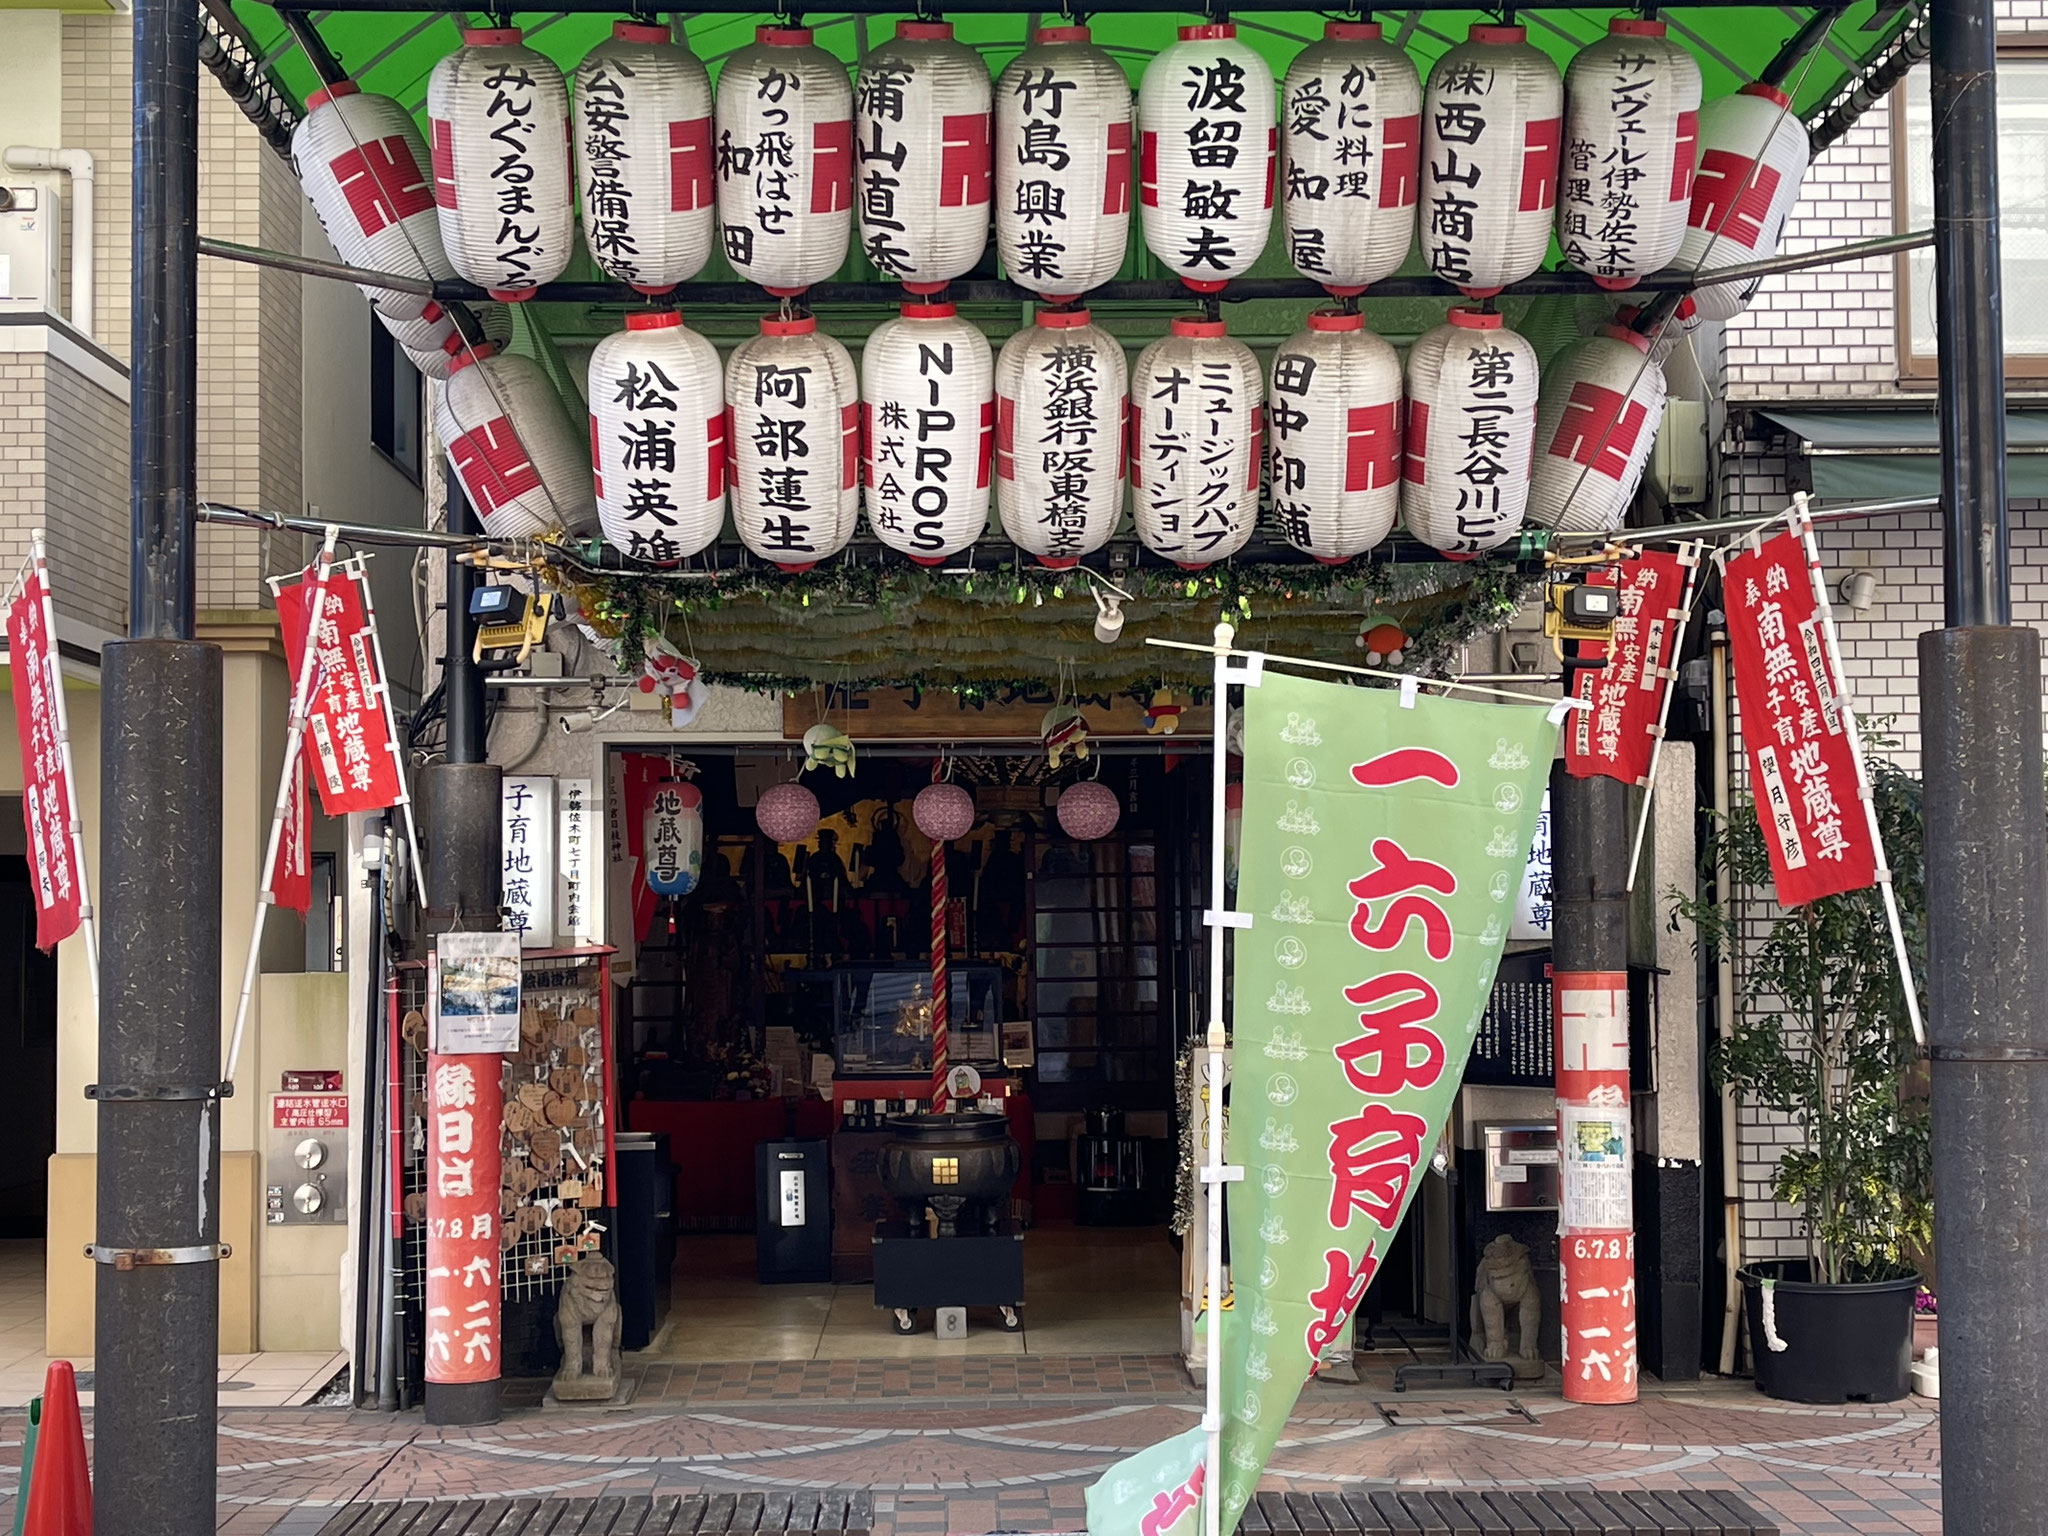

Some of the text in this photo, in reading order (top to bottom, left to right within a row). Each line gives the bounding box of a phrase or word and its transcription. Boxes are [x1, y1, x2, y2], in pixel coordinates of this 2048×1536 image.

[484, 63, 541, 289] みんぐるまんぐる
[584, 58, 647, 285] 公安警備保障
[719, 130, 754, 266] 和田
[754, 68, 800, 235] かっ飛ばせ
[857, 64, 917, 279] 蒲山直秀
[1014, 68, 1077, 279] 竹島興業
[1180, 57, 1247, 270] 波留敏夫
[1286, 78, 1331, 276] 愛知屋
[1333, 64, 1376, 200] かに料理
[1563, 139, 1597, 266] 管理組合
[1594, 54, 1656, 278] サンヴェール伊勢佐木町
[613, 360, 681, 562] 松浦英雄
[750, 364, 815, 553] 阿部蓮生
[877, 400, 910, 534] 株式会社
[909, 343, 956, 551] NIPROS
[1149, 367, 1191, 552] オーディション
[1192, 363, 1240, 552] ミュージックパブ
[1448, 346, 1515, 552] 第二長谷川ビル
[504, 783, 534, 938] 子育地蔵尊
[653, 790, 683, 883] 地蔵尊
